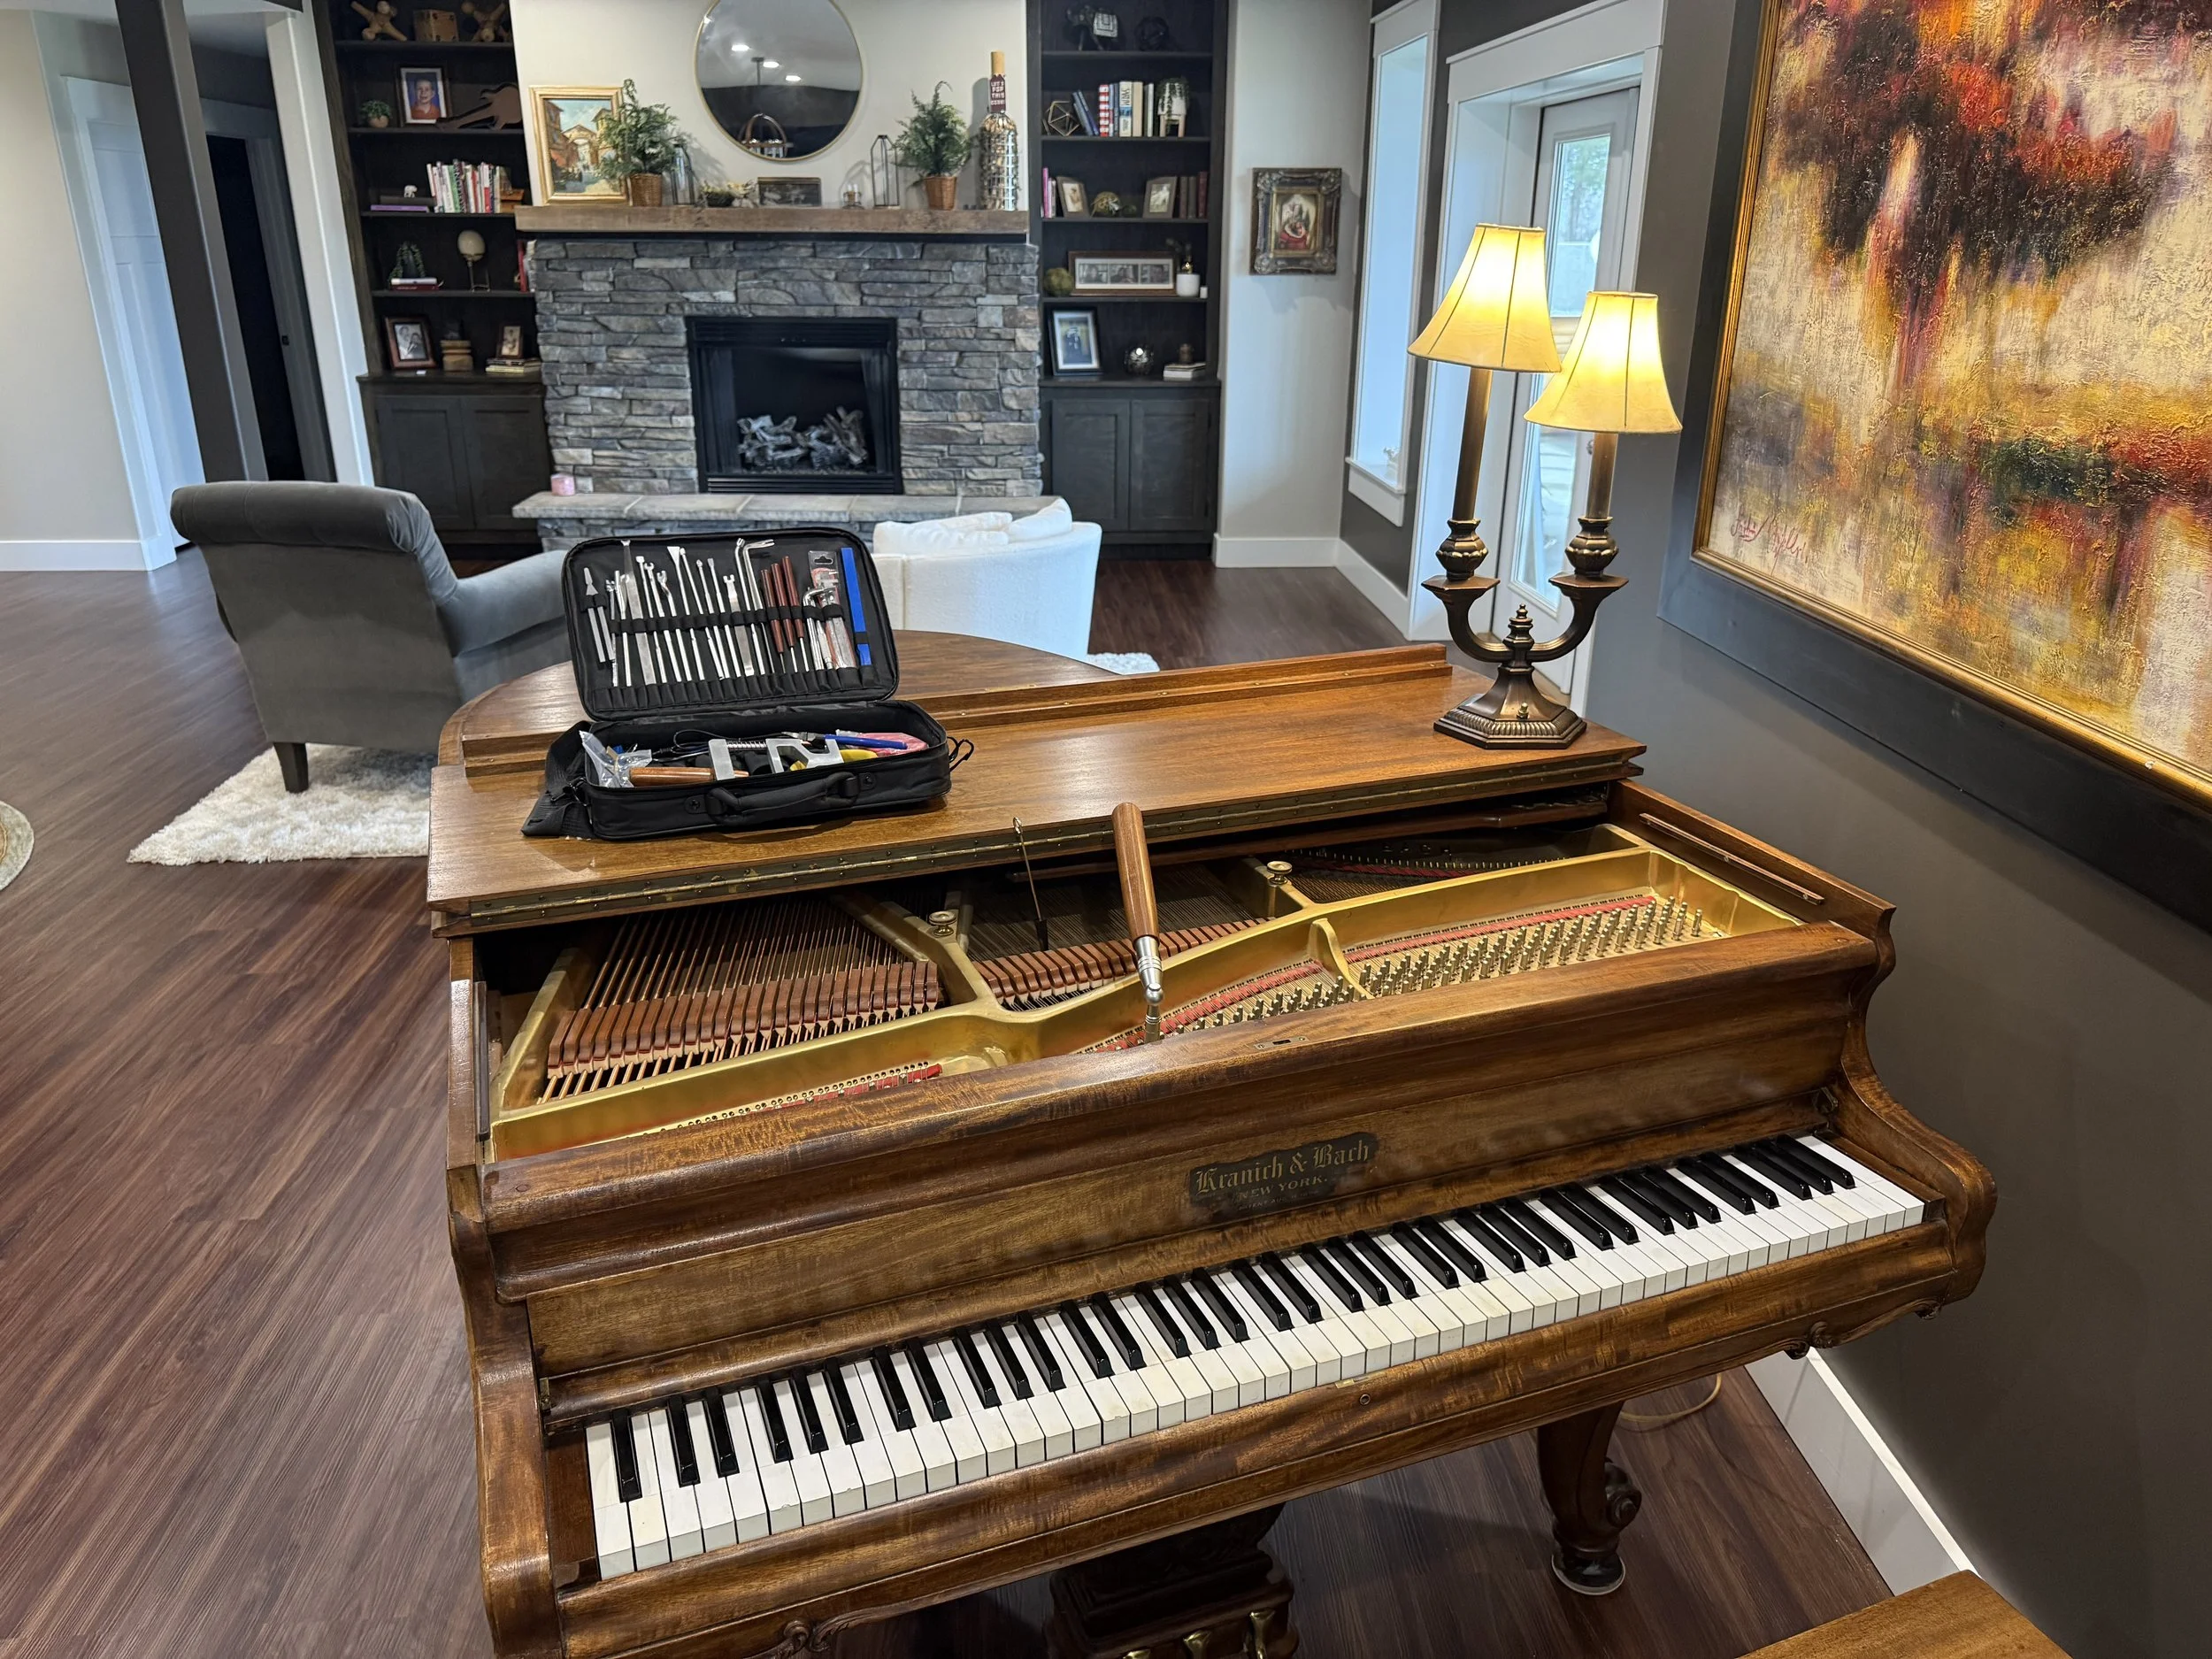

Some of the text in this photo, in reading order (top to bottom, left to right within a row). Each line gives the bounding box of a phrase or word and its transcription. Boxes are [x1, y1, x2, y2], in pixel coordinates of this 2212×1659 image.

[1196, 1140, 1368, 1194] Kranich & Bach
[1239, 1186, 1273, 1201] NEW
